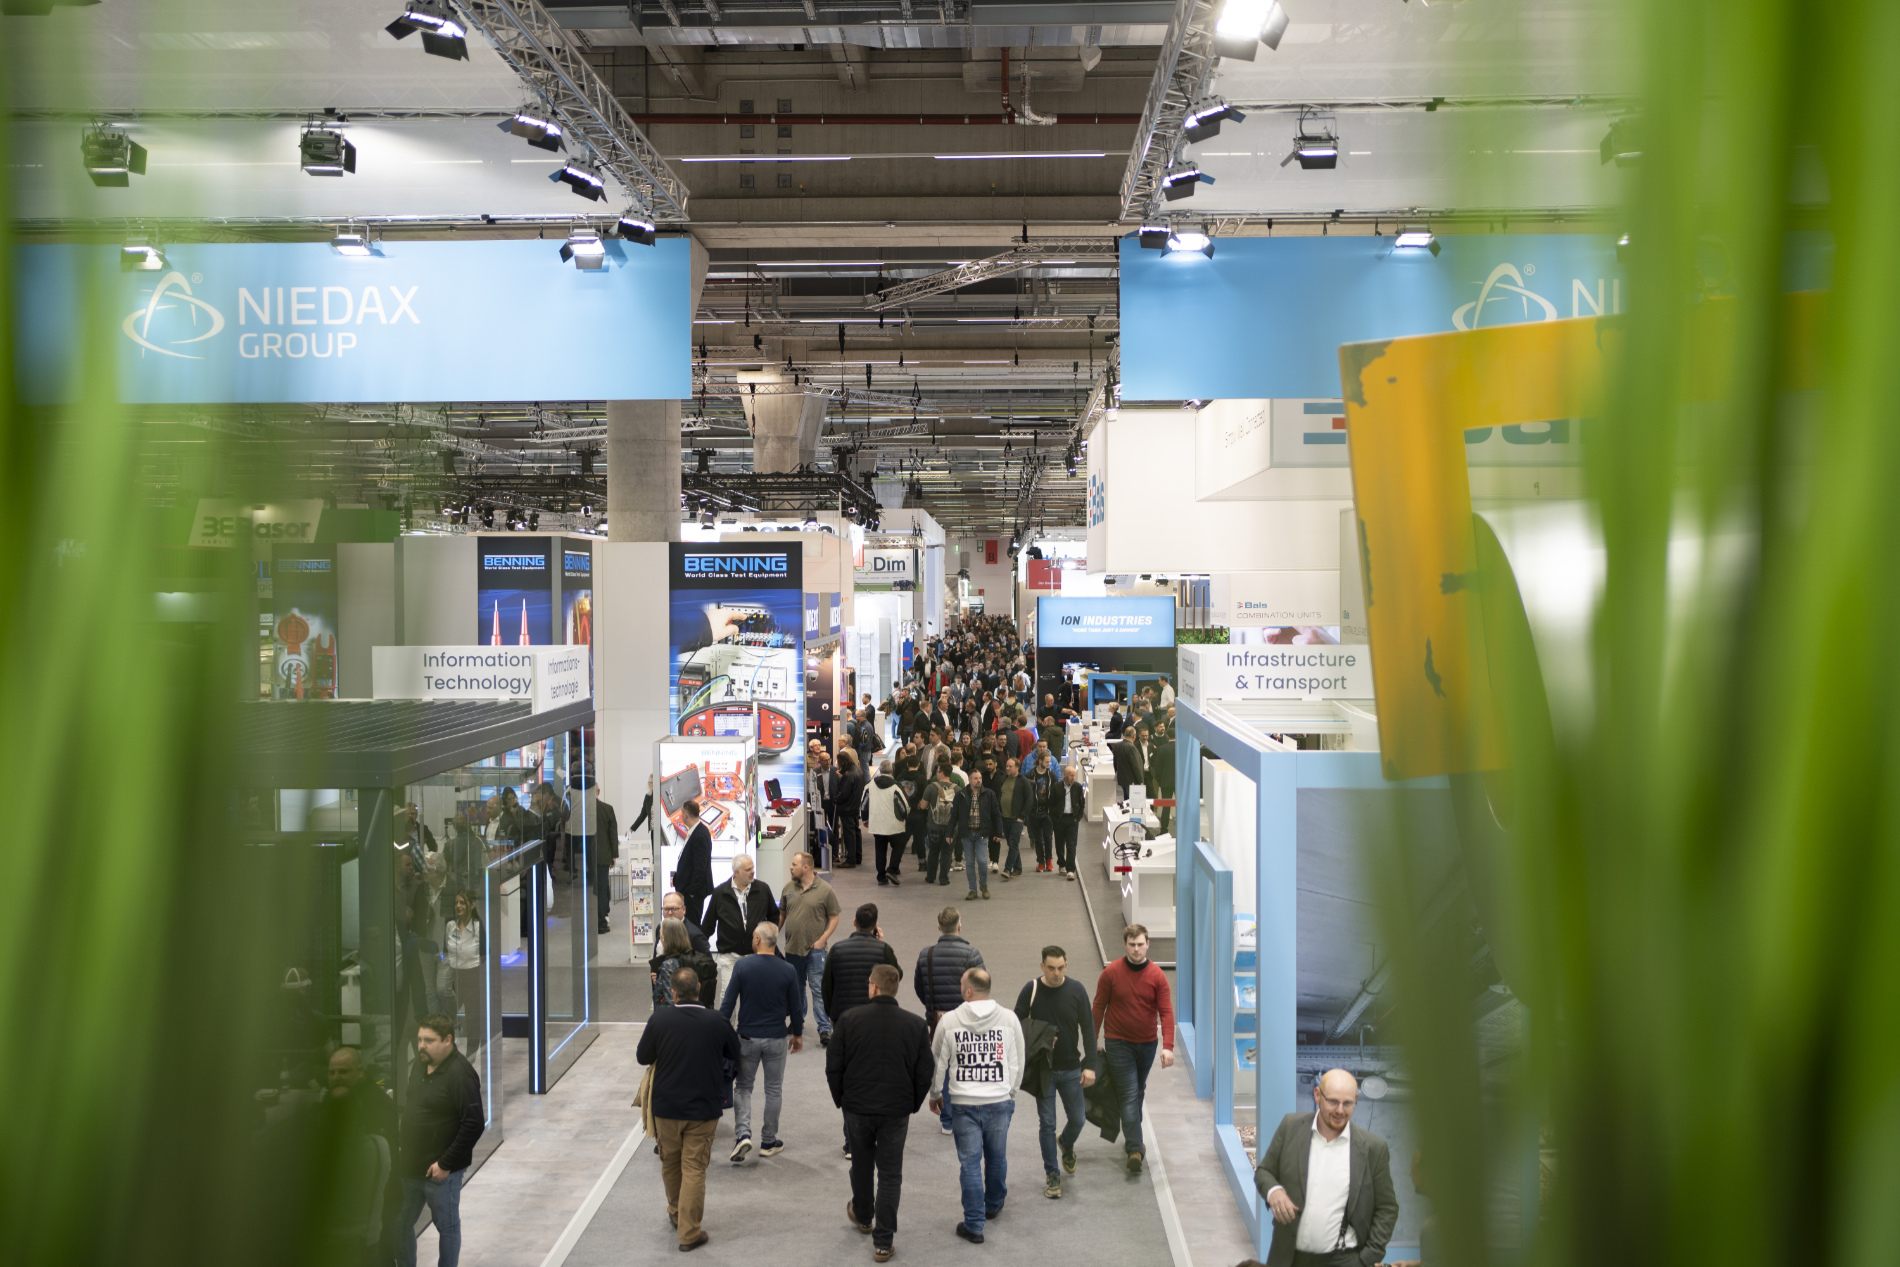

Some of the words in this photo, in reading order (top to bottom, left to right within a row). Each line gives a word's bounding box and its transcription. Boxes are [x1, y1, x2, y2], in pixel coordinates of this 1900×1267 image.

[238, 286, 420, 325] NIEDAX
[239, 332, 357, 358] GROUP
[484, 557, 545, 566] BENNING
[565, 554, 589, 571] BENNING
[684, 557, 787, 572] BENNING
[988, 552, 995, 562] B
[1244, 601, 1268, 609] Bals
[1061, 615, 1080, 626] ION
[1083, 615, 1152, 626] INDUSTRIES
[423, 652, 532, 667] Information
[548, 655, 580, 676] Informations-
[1227, 651, 1356, 667] Infrastructure
[424, 674, 532, 694] Technology
[551, 679, 579, 699] technologie
[1235, 675, 1249, 690] &
[1255, 675, 1347, 694] Transport
[955, 1030, 1003, 1043] KAISERS
[956, 1043, 997, 1053] LAUTERN
[956, 1053, 996, 1065] ROTE
[958, 1067, 1003, 1081] TEUFEL
